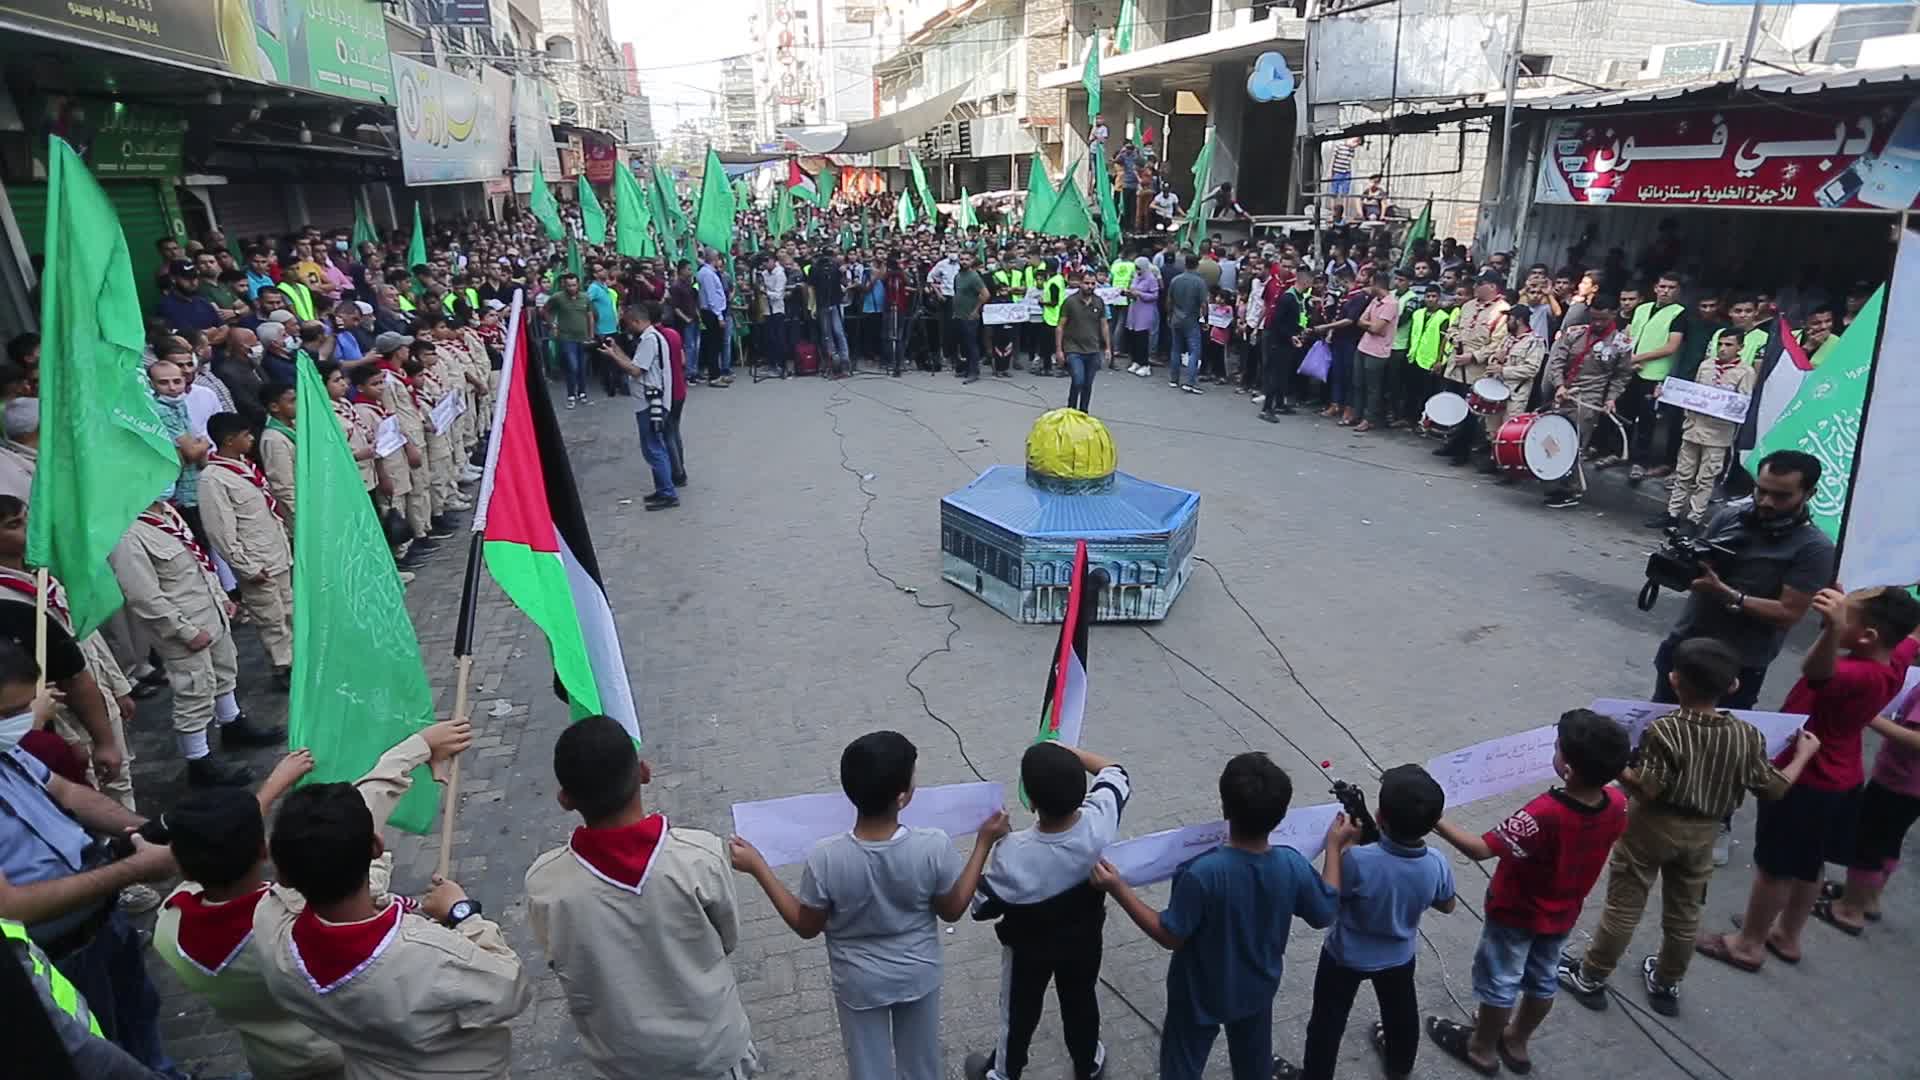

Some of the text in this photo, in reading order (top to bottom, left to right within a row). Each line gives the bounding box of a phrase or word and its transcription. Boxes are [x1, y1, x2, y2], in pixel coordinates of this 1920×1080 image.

[1594, 114, 1874, 178] دبي فون
[1638, 182, 1797, 204] للأجهزة الخلوية ومستلزماتها
